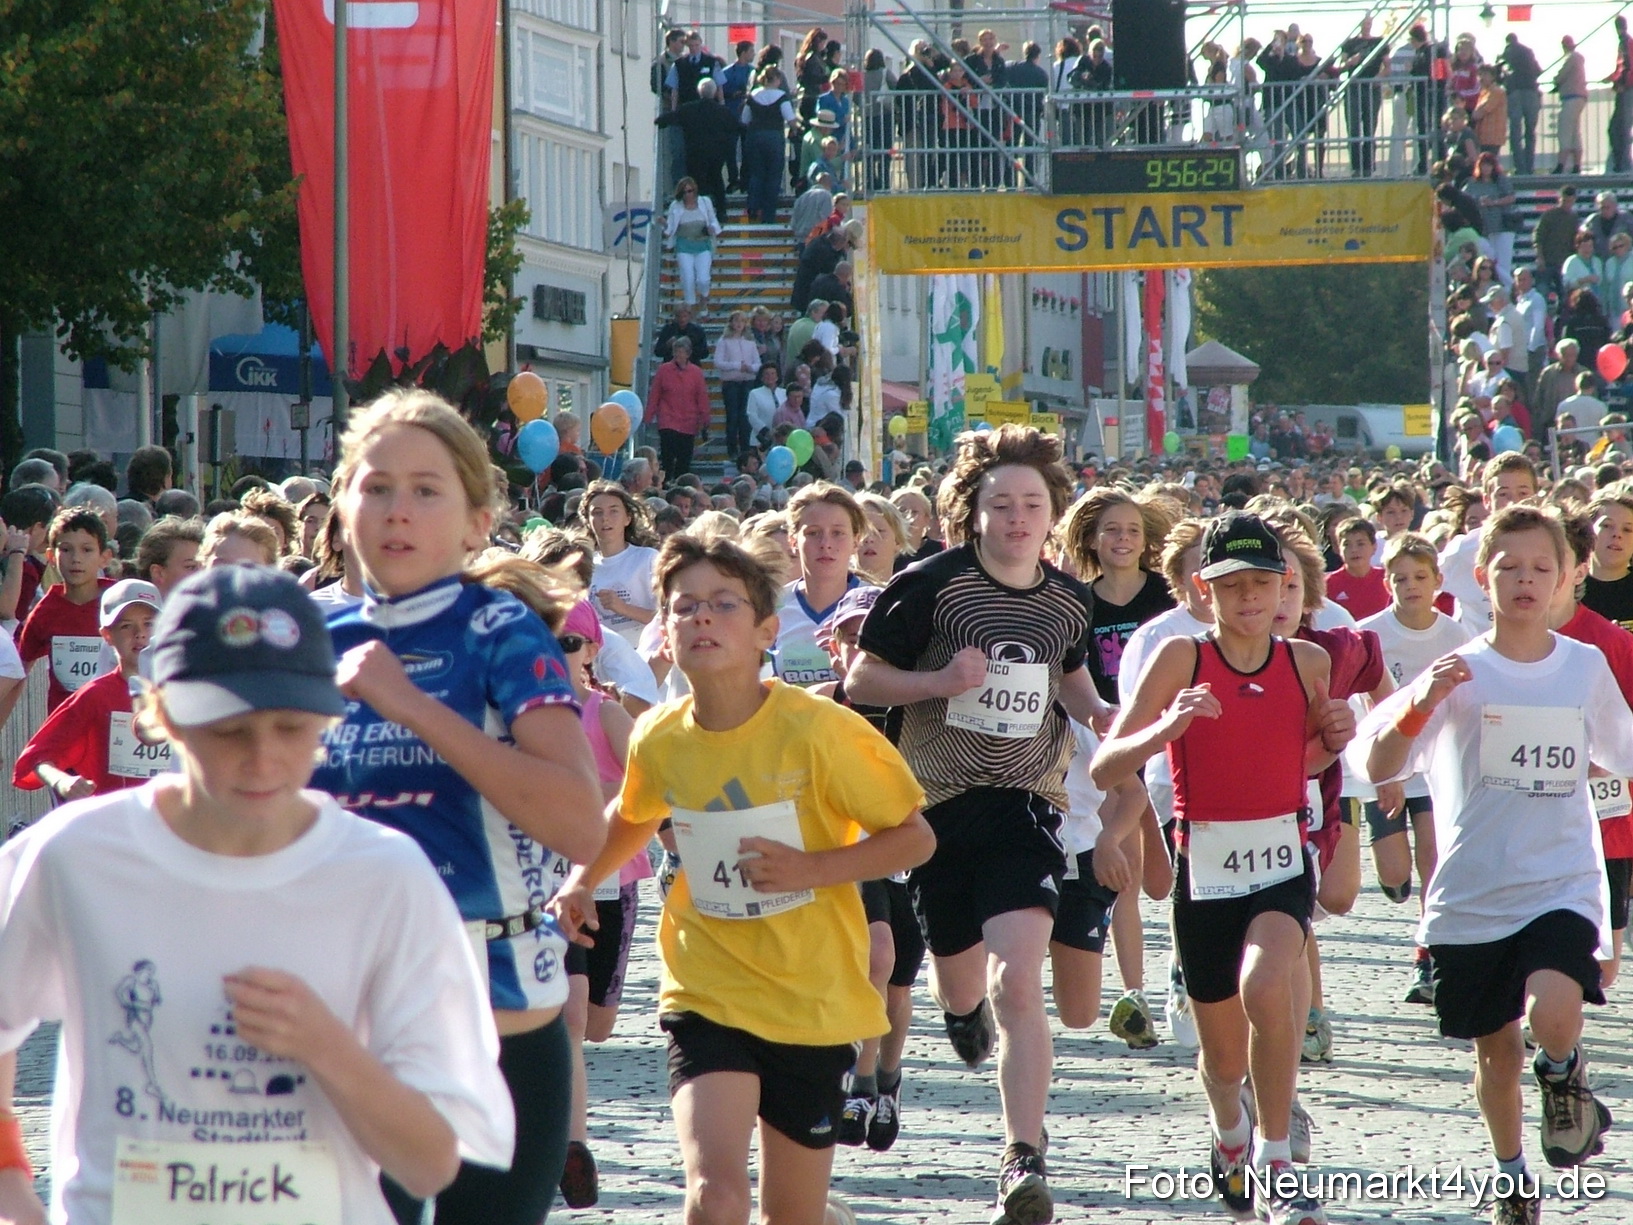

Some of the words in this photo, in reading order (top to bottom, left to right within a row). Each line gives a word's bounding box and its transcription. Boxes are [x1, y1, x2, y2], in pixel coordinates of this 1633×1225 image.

[904, 235, 968, 245] Neumarkter
[1055, 205, 1244, 251] START
[1032, 414, 1055, 424] Block
[69, 641, 101, 653] Samuel
[978, 687, 1041, 713] 4056
[363, 720, 419, 742] ERG
[1511, 744, 1576, 769] 4150
[1223, 845, 1293, 873] 4119
[115, 1087, 149, 1120] 8.
[158, 1101, 306, 1130] Neumarkter
